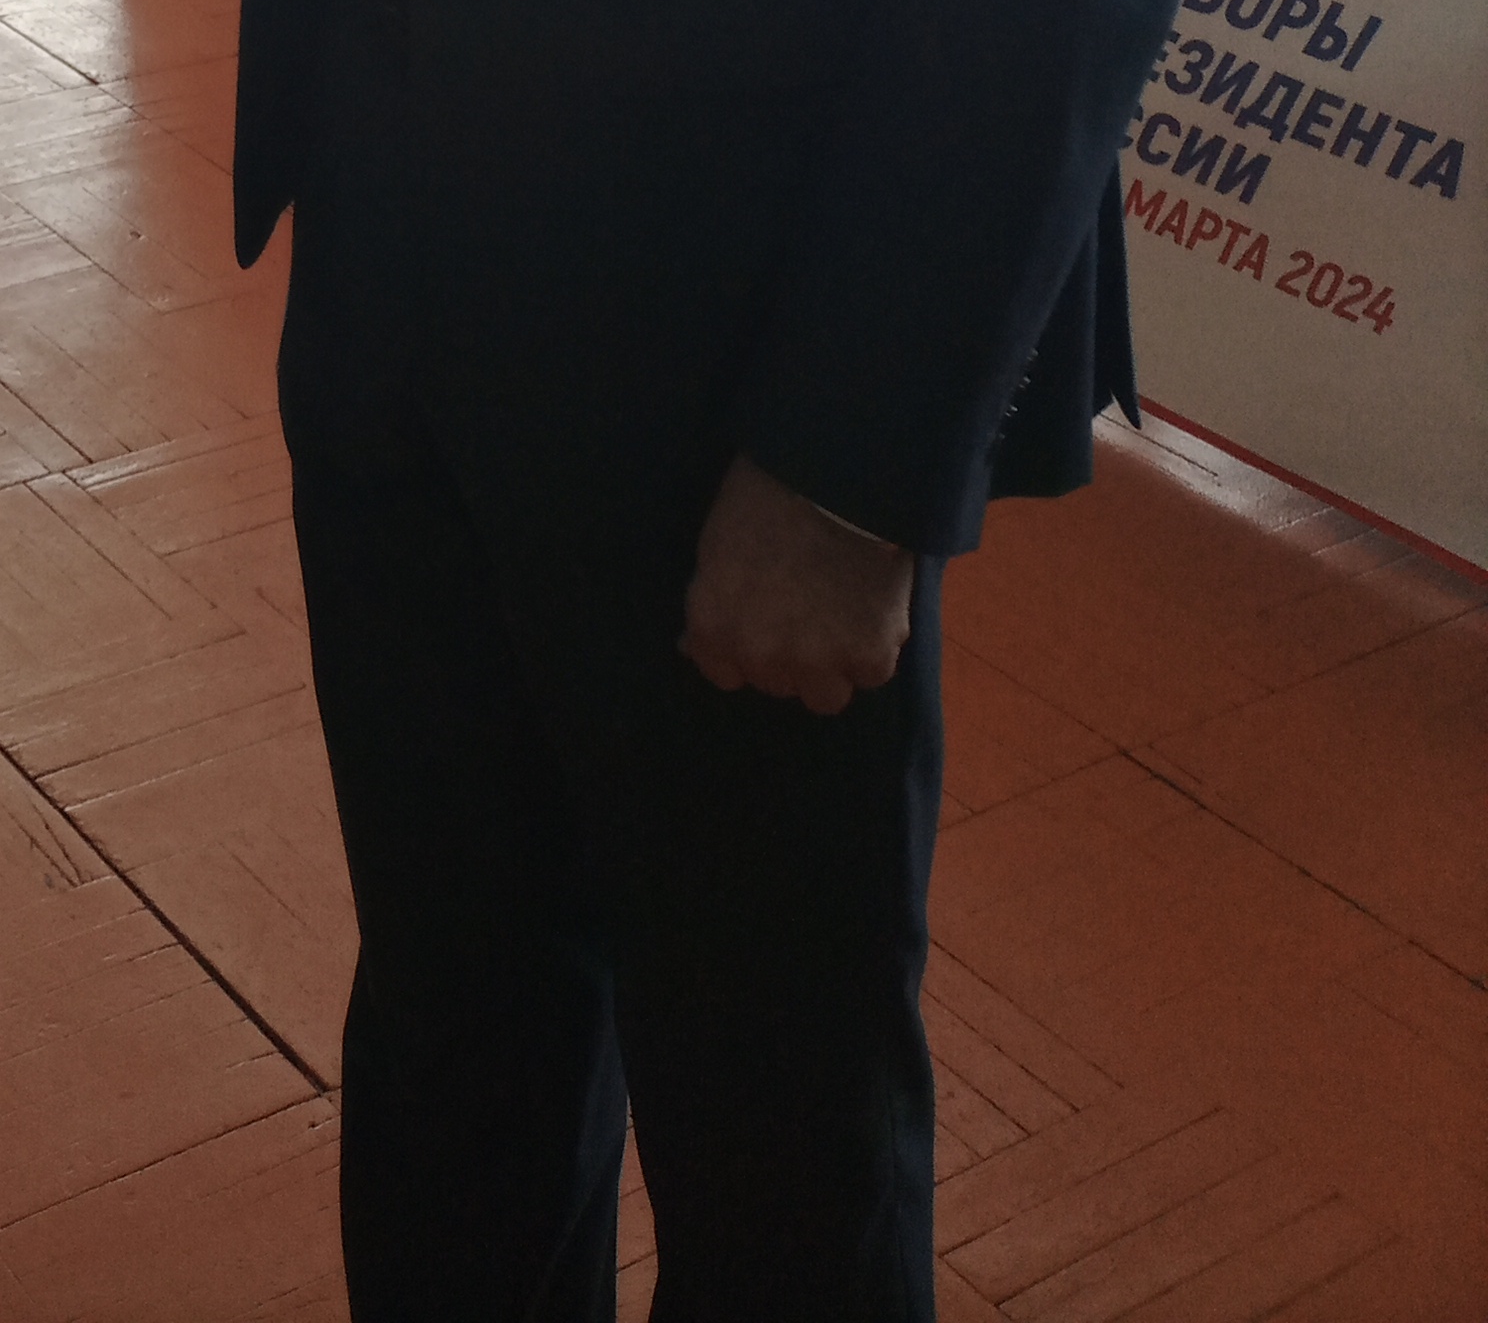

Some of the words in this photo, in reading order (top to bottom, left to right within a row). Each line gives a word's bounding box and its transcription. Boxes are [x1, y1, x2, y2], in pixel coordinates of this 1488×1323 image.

[1124, 105, 1272, 205] СИИ
[1124, 178, 1271, 281] МАРТА
[1274, 249, 1396, 336] 2024
